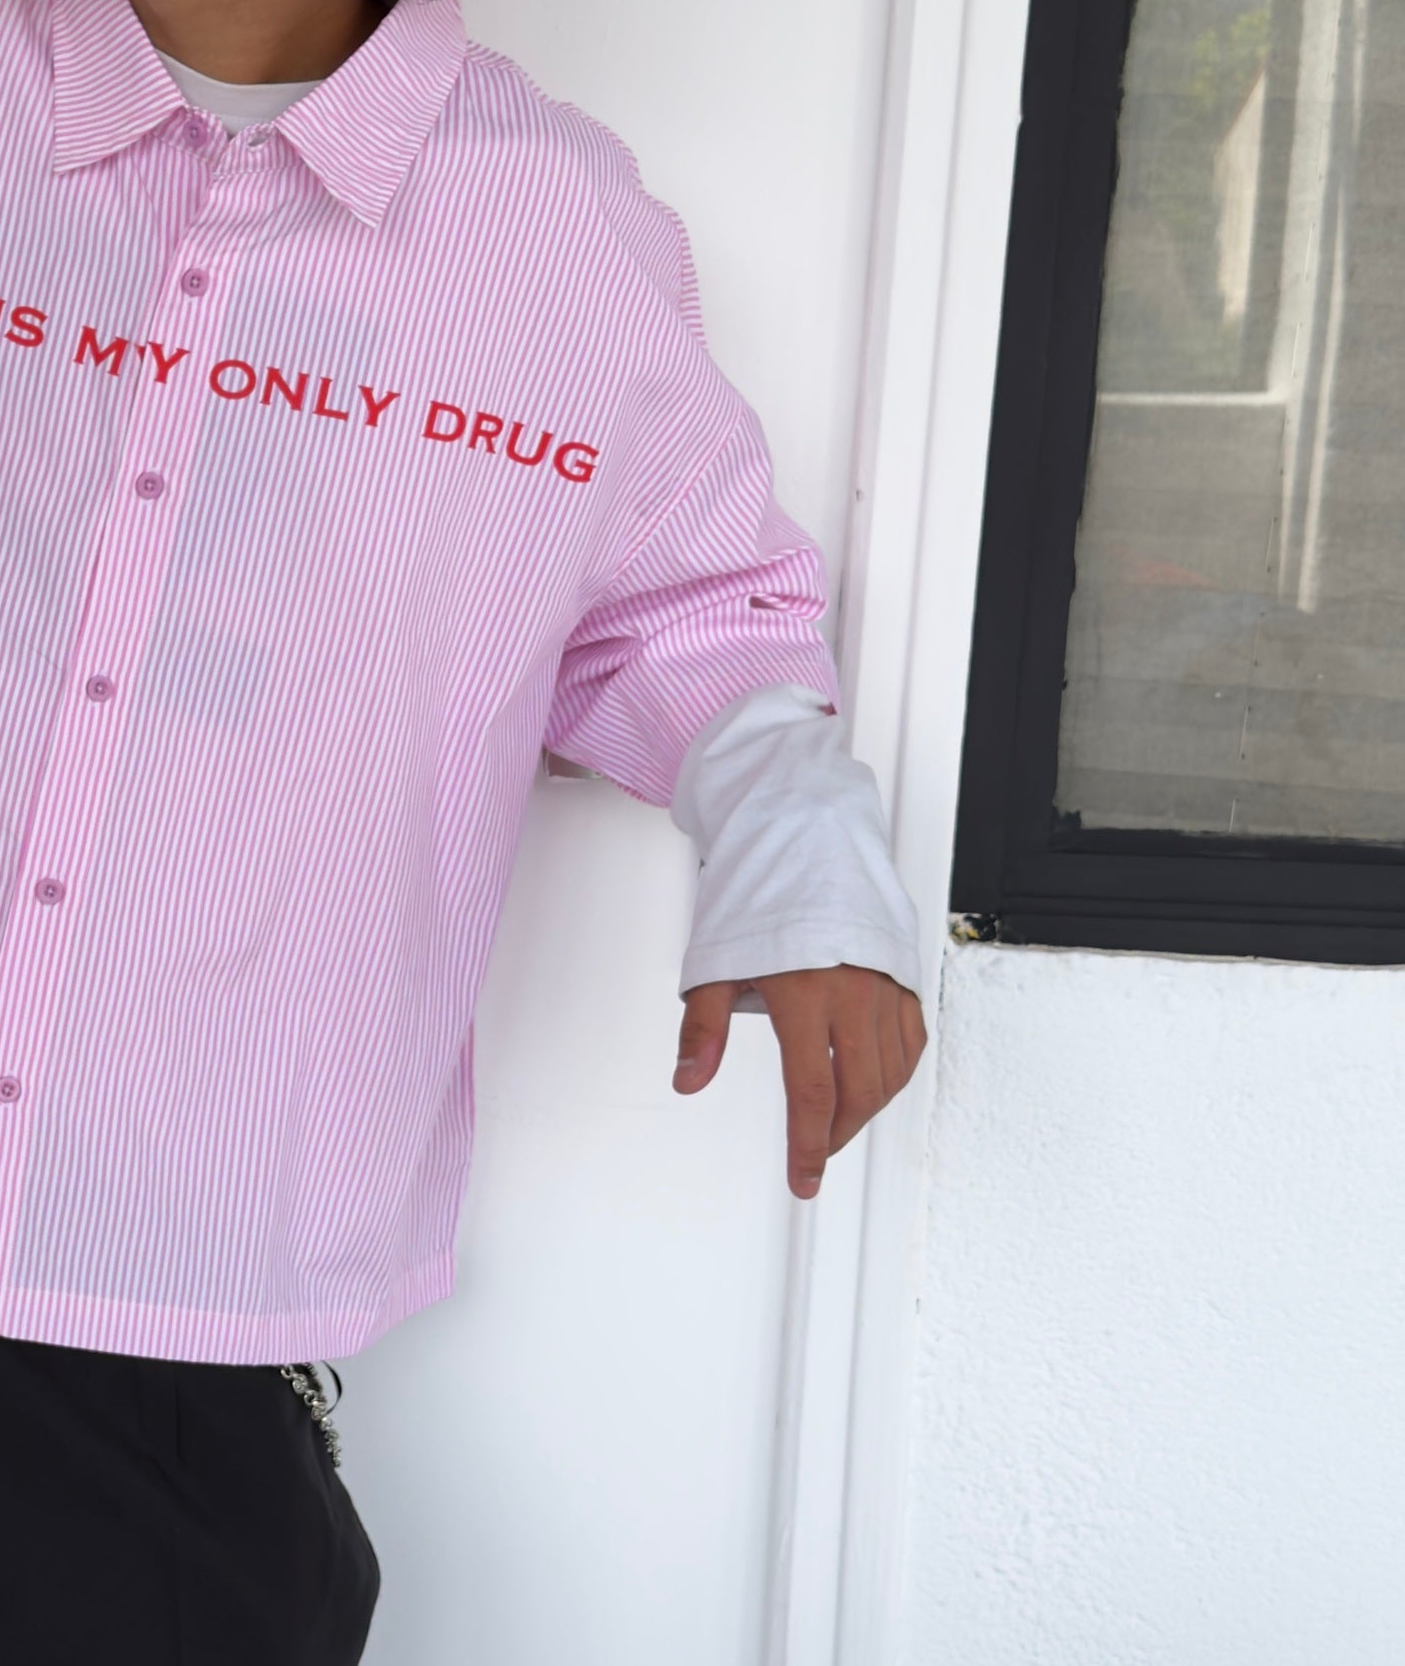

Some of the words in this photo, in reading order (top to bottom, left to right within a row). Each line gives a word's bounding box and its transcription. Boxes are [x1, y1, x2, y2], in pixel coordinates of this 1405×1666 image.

[73, 325, 191, 385] MY
[208, 358, 401, 428] ONLY
[421, 400, 600, 484] DRUG
